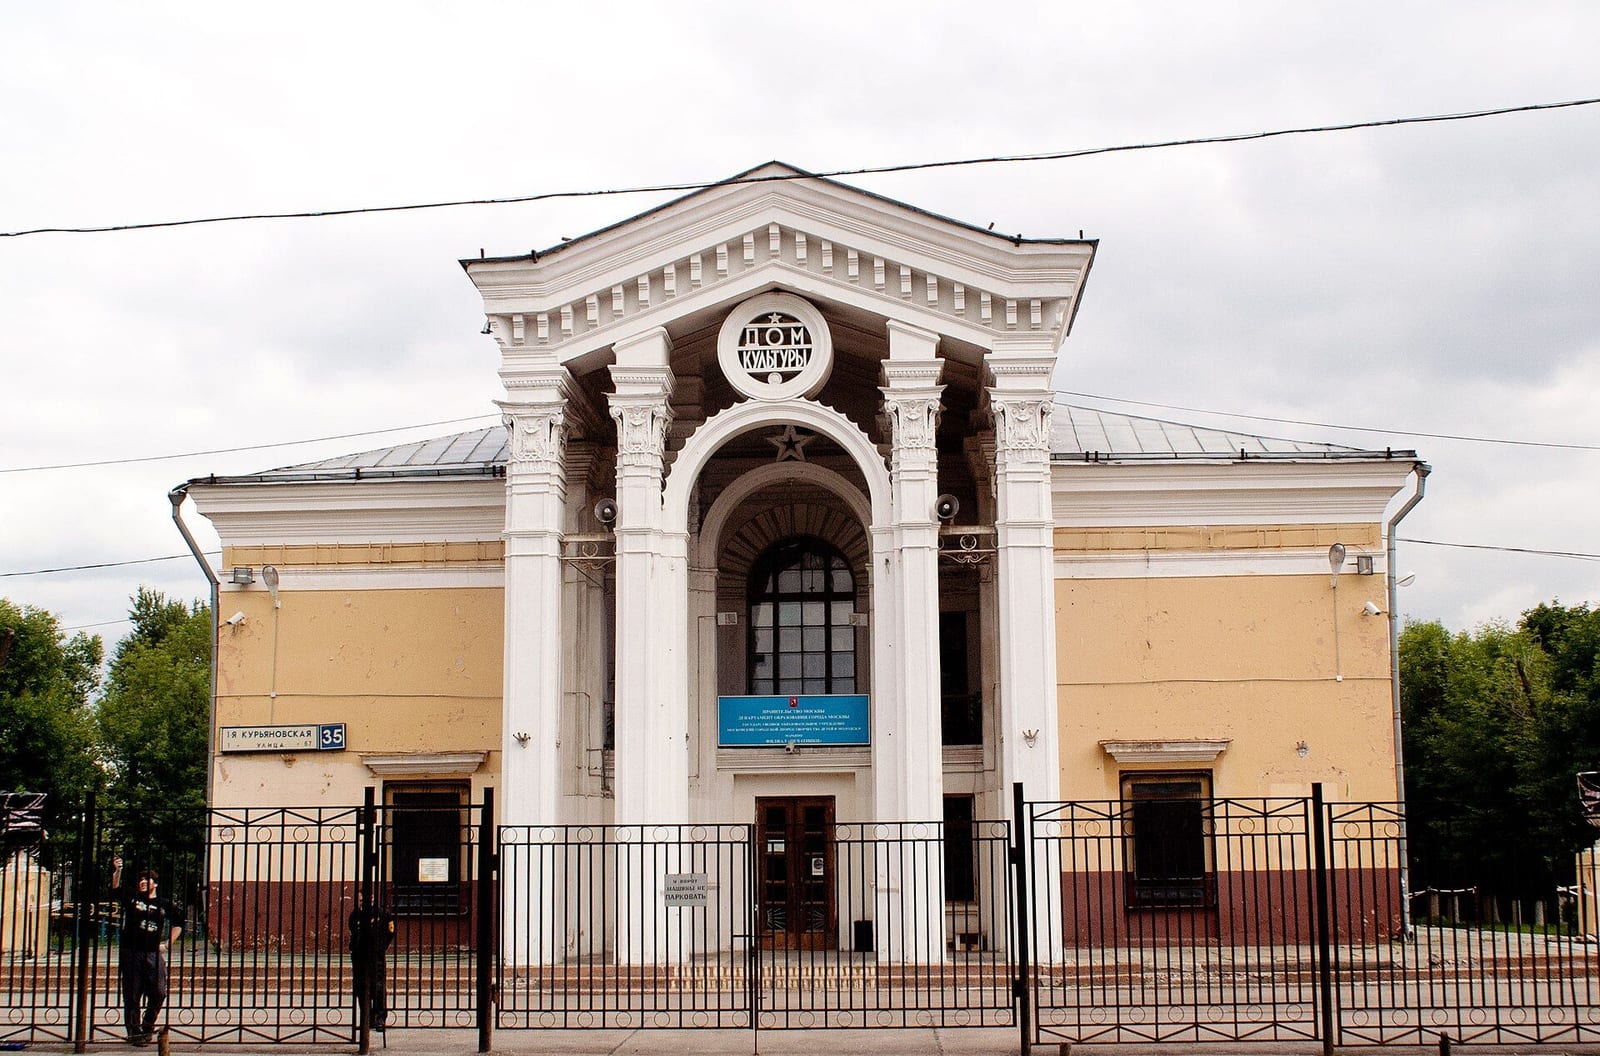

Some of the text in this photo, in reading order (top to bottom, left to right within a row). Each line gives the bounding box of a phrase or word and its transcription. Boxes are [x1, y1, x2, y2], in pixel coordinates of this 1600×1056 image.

[745, 327, 804, 347] ДОМ
[743, 349, 807, 369] КУЛЬТУРЫ
[241, 730, 312, 739] КУРЬЯНОВСКАЯ
[322, 729, 343, 744] 35
